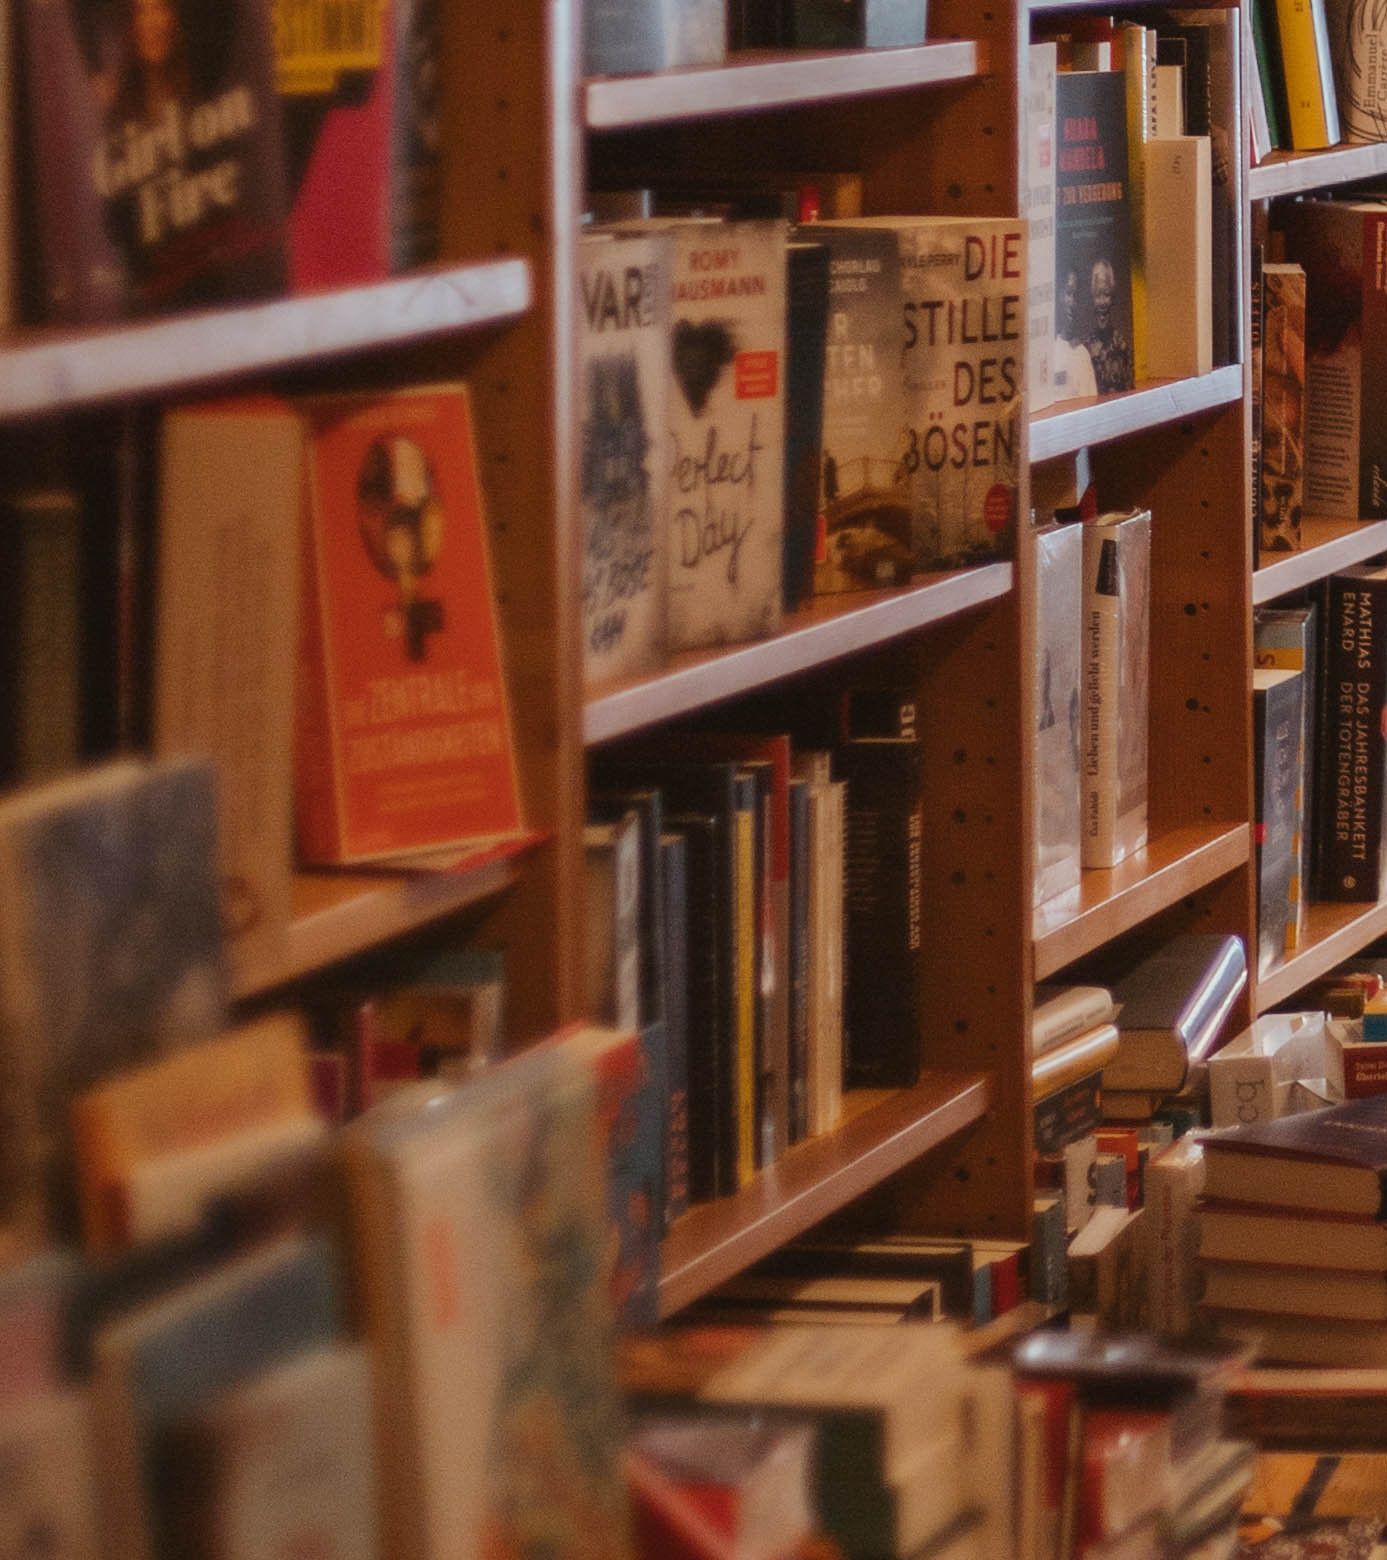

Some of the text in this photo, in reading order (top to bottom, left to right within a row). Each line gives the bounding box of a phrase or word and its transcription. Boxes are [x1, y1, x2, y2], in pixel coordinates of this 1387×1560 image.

[1362, 32, 1378, 109] Emmanuel
[964, 231, 1022, 283] DIE
[903, 294, 1020, 349] STILLE
[953, 358, 1018, 408] DES
[905, 413, 1018, 473] BÖSEN
[675, 505, 751, 583] Day
[1087, 610, 1101, 777] Lieben und geliebt werden
[1335, 591, 1357, 843] ENARD DER TOTENGRÄBER
[1351, 591, 1372, 861] MATHIAS DAS JAHRESBANKETT
